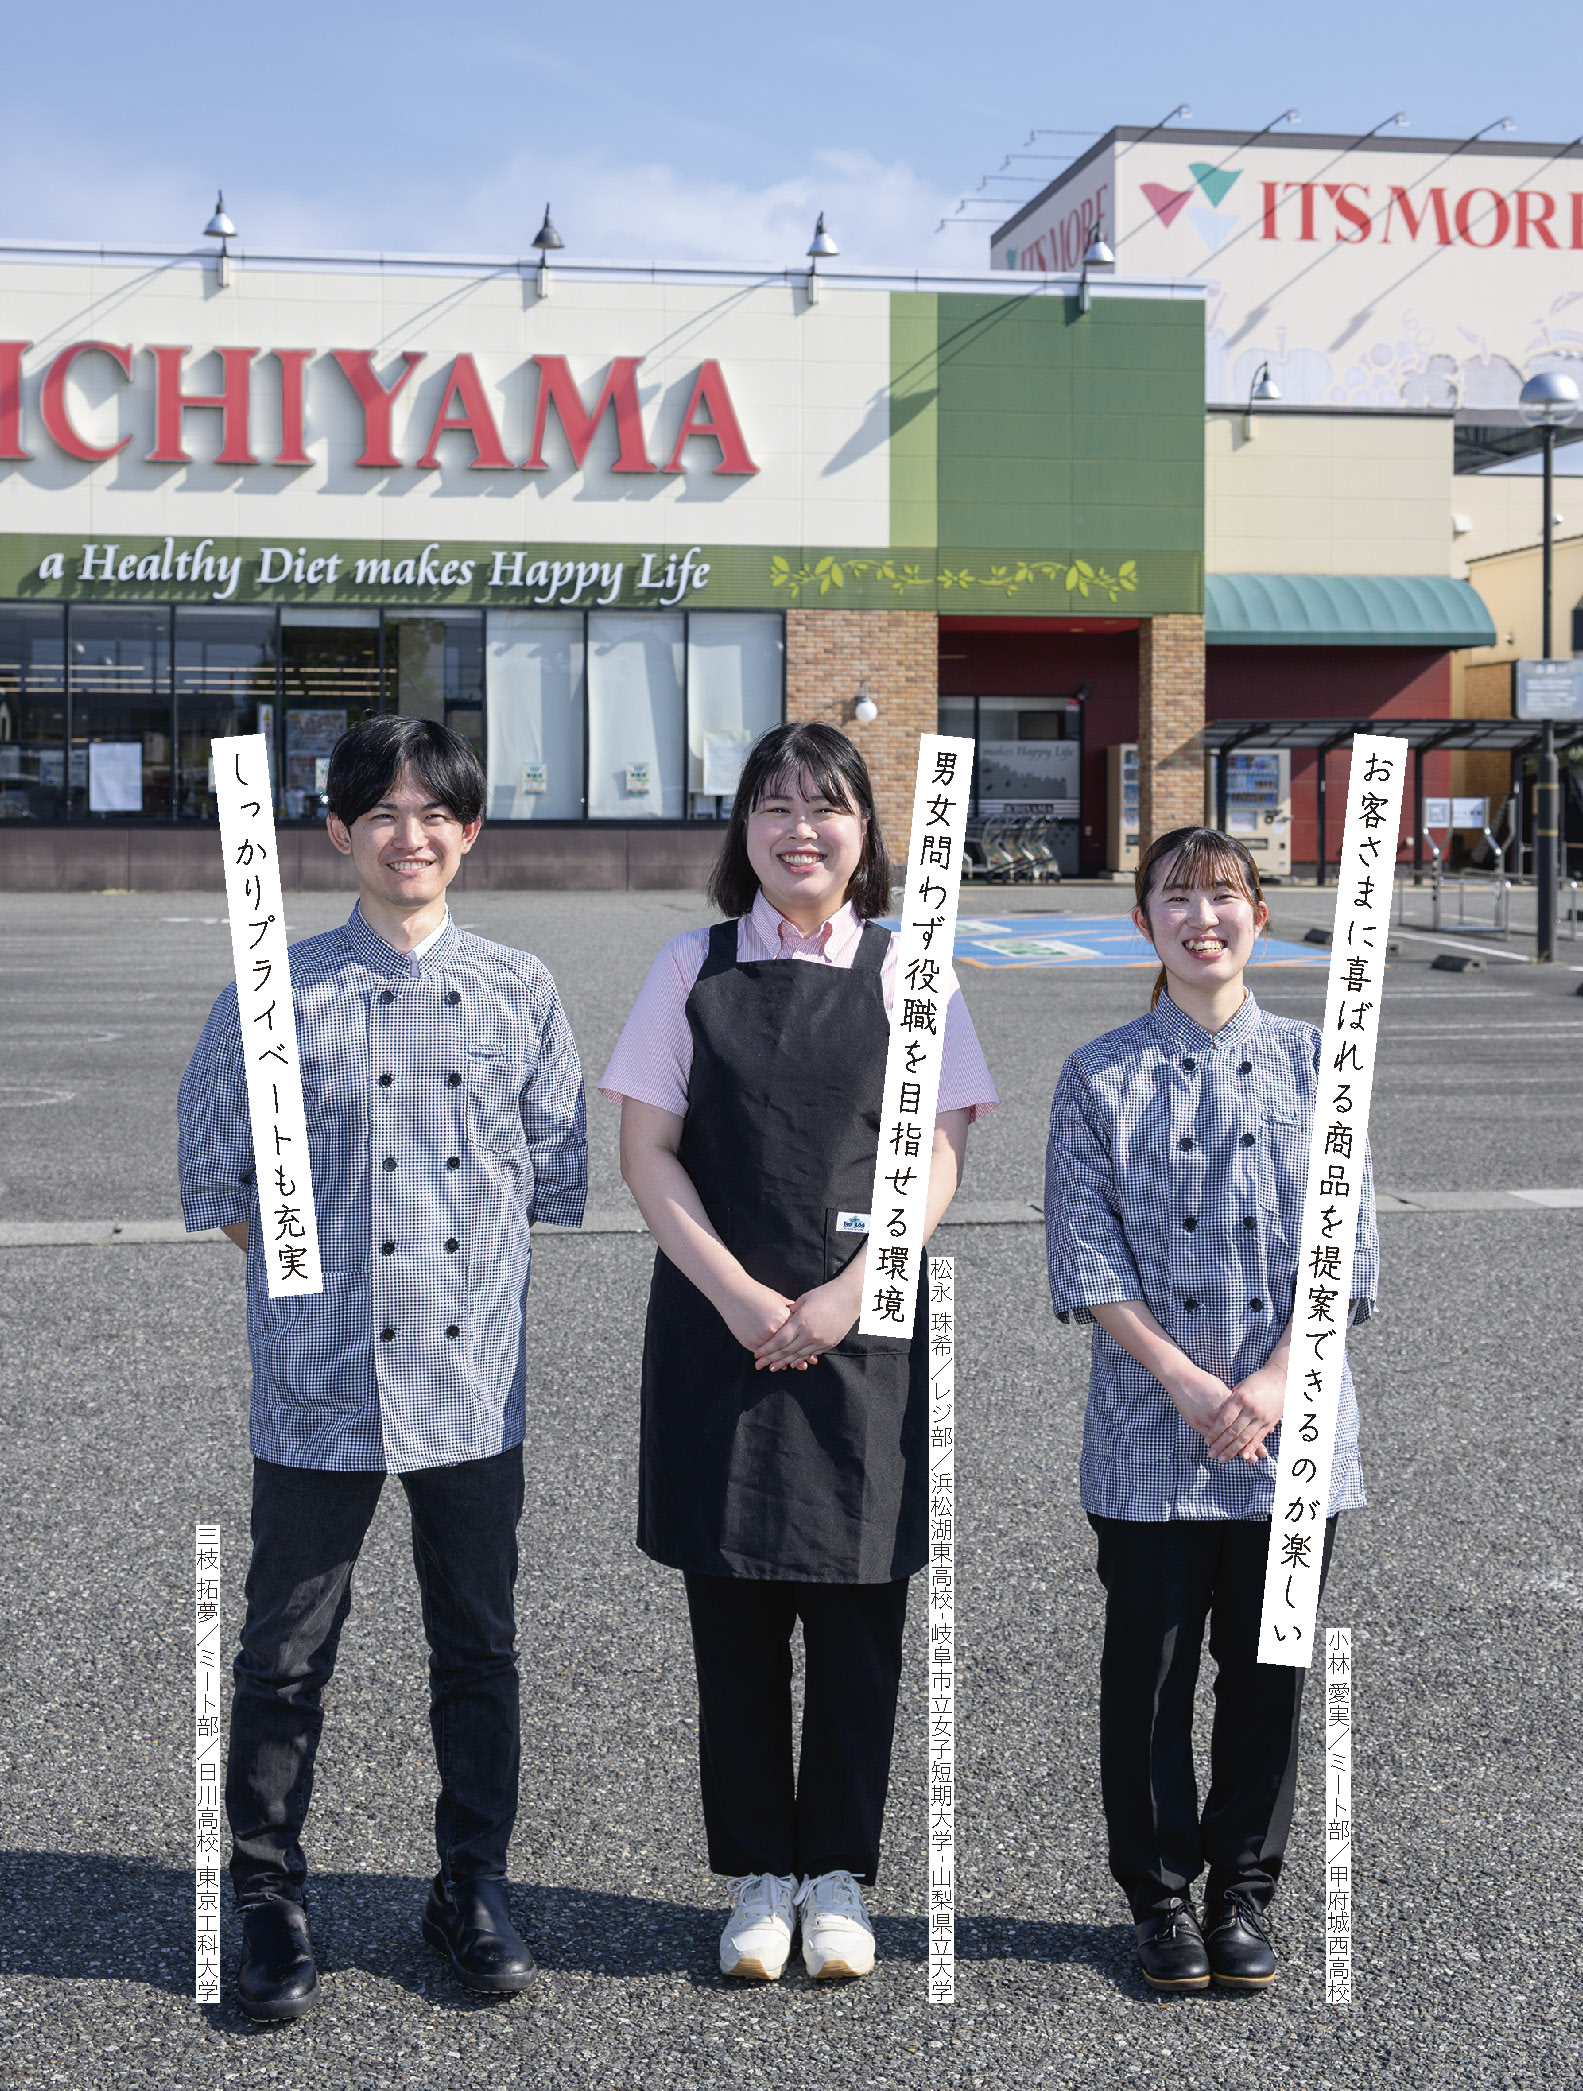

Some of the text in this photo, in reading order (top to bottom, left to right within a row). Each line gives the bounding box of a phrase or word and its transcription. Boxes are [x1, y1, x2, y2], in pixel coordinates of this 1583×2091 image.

[0, 340, 760, 475] ICHIYAMA
[38, 536, 712, 607] a Healthy Diet makes Happy Life
